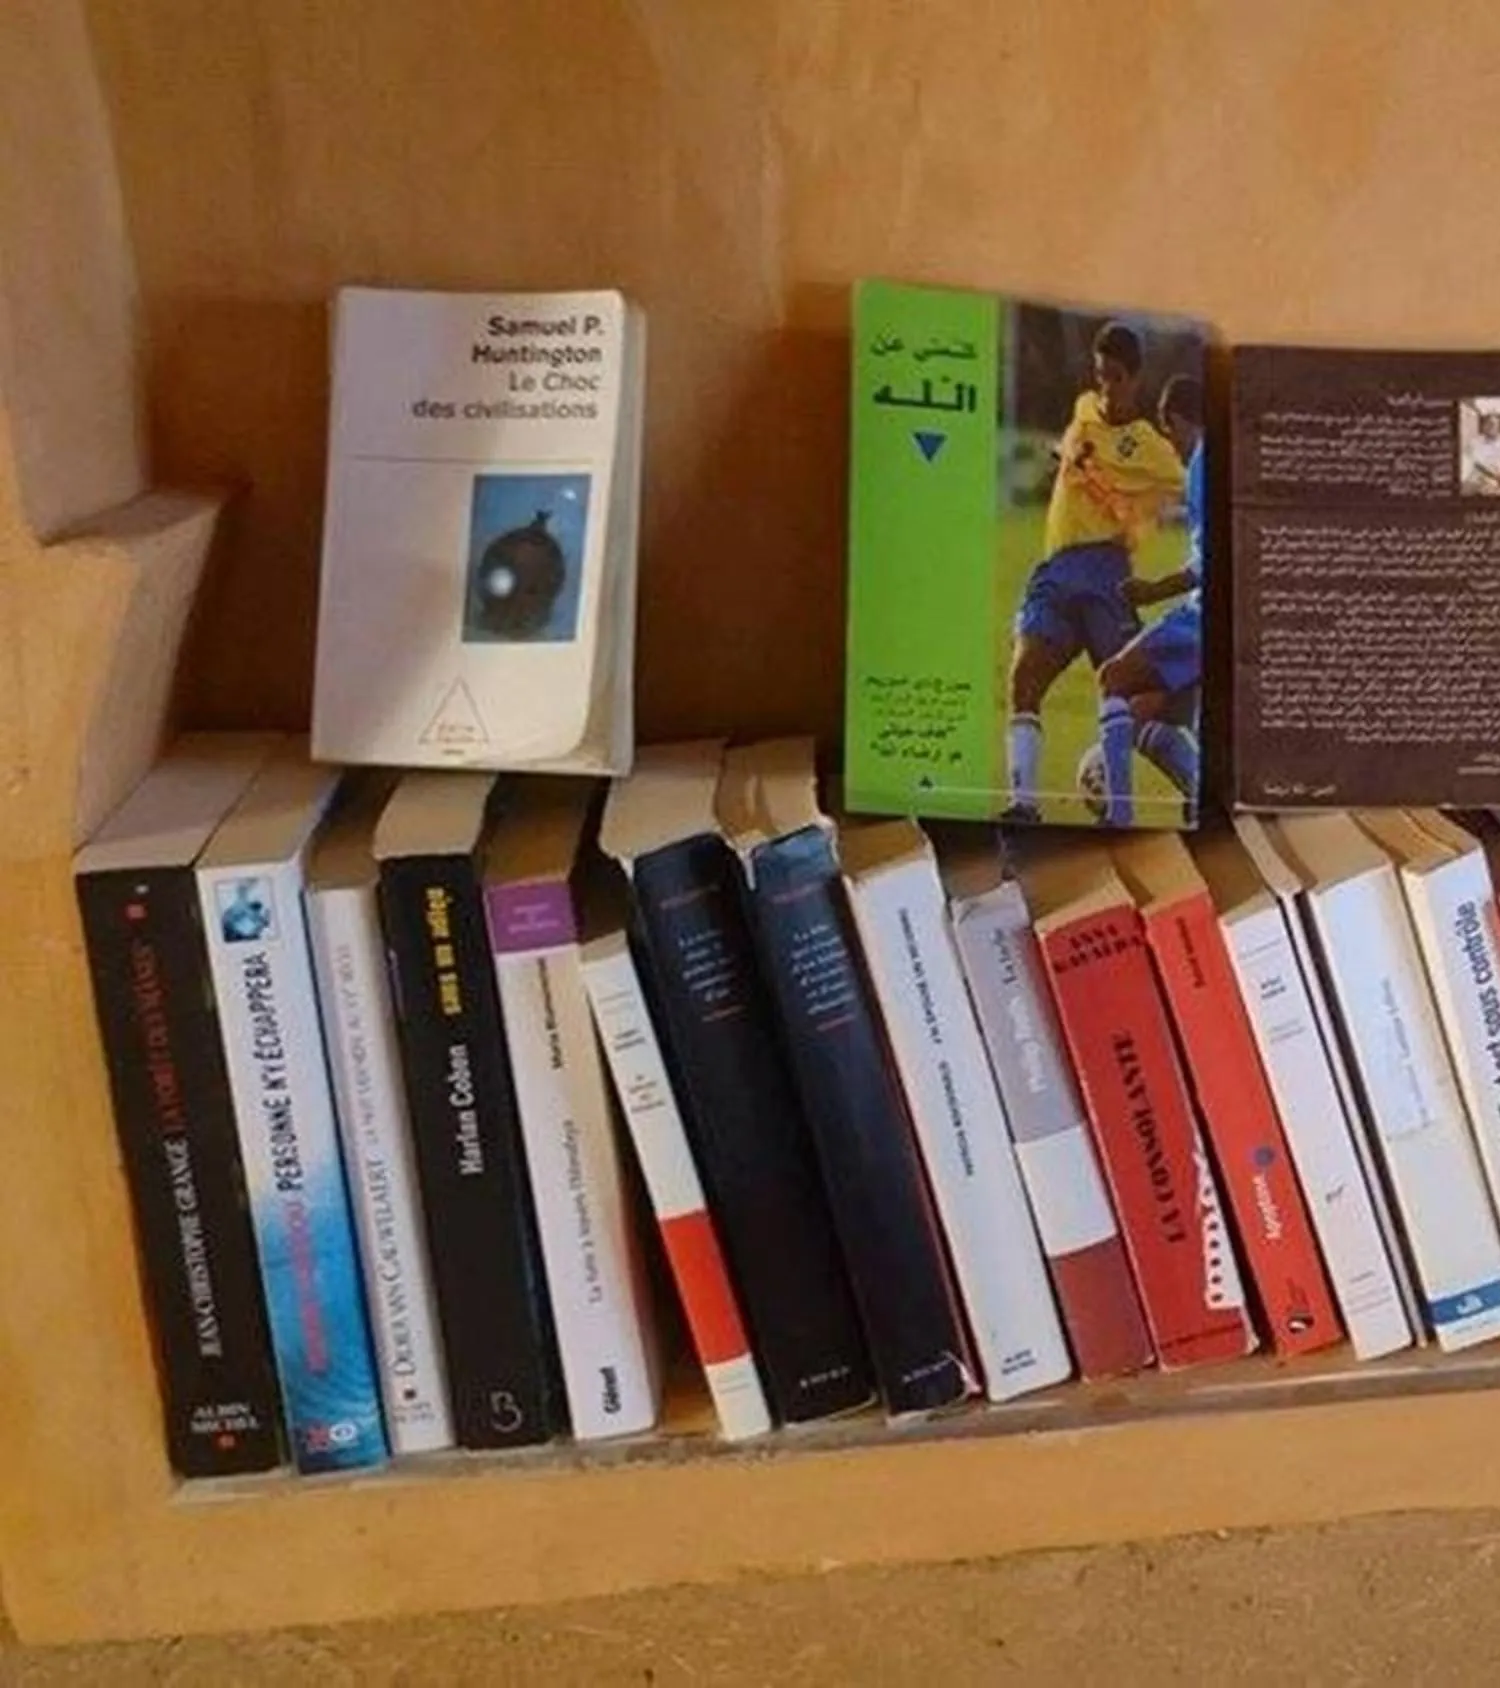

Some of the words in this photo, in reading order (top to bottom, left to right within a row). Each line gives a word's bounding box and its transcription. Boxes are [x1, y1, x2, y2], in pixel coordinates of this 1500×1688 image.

[487, 316, 576, 336] Samuel
[583, 316, 604, 335] P.
[471, 345, 602, 368] Huntington
[508, 370, 537, 391] Le
[543, 372, 600, 391] Choc
[412, 399, 455, 418] des
[463, 401, 597, 419] civilisations
[1449, 901, 1496, 990] contrôle
[242, 952, 284, 1064] ÉCHAPPERA
[441, 1043, 474, 1108] Coben
[262, 1098, 303, 1193] PERSONNE
[452, 1111, 484, 1174] Harlan
[1159, 1206, 1188, 1247] LA
